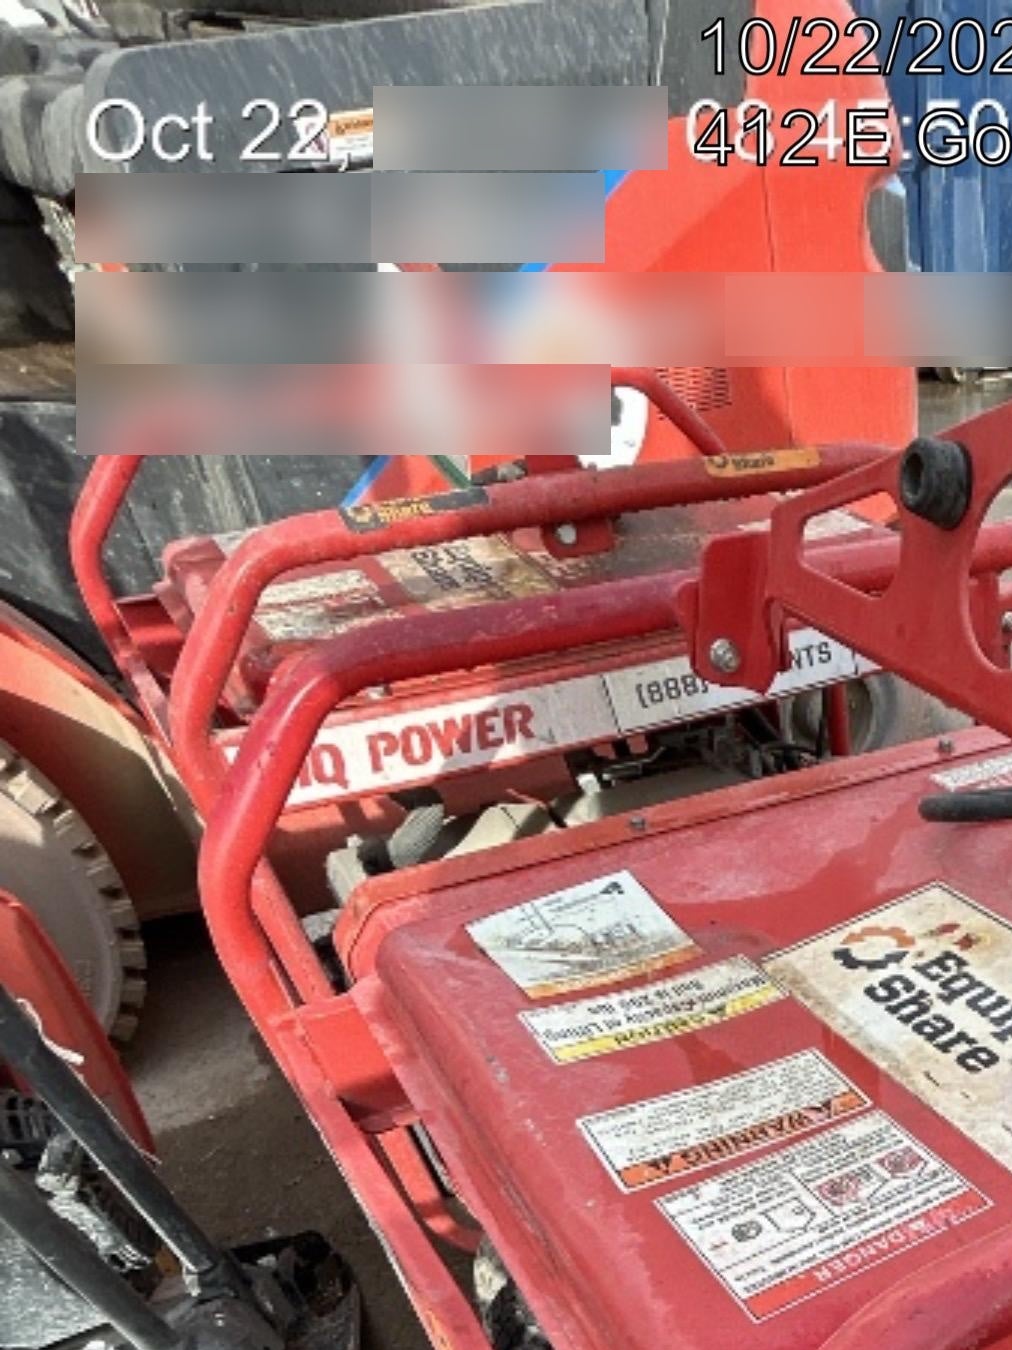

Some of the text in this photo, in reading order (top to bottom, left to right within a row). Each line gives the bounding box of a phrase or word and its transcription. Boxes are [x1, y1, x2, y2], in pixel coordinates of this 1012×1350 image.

[366, 702, 535, 774] POWER
[864, 974, 1000, 1073] Share
[683, 1109, 812, 1159] WARNING
[813, 1232, 904, 1282] DANGER
